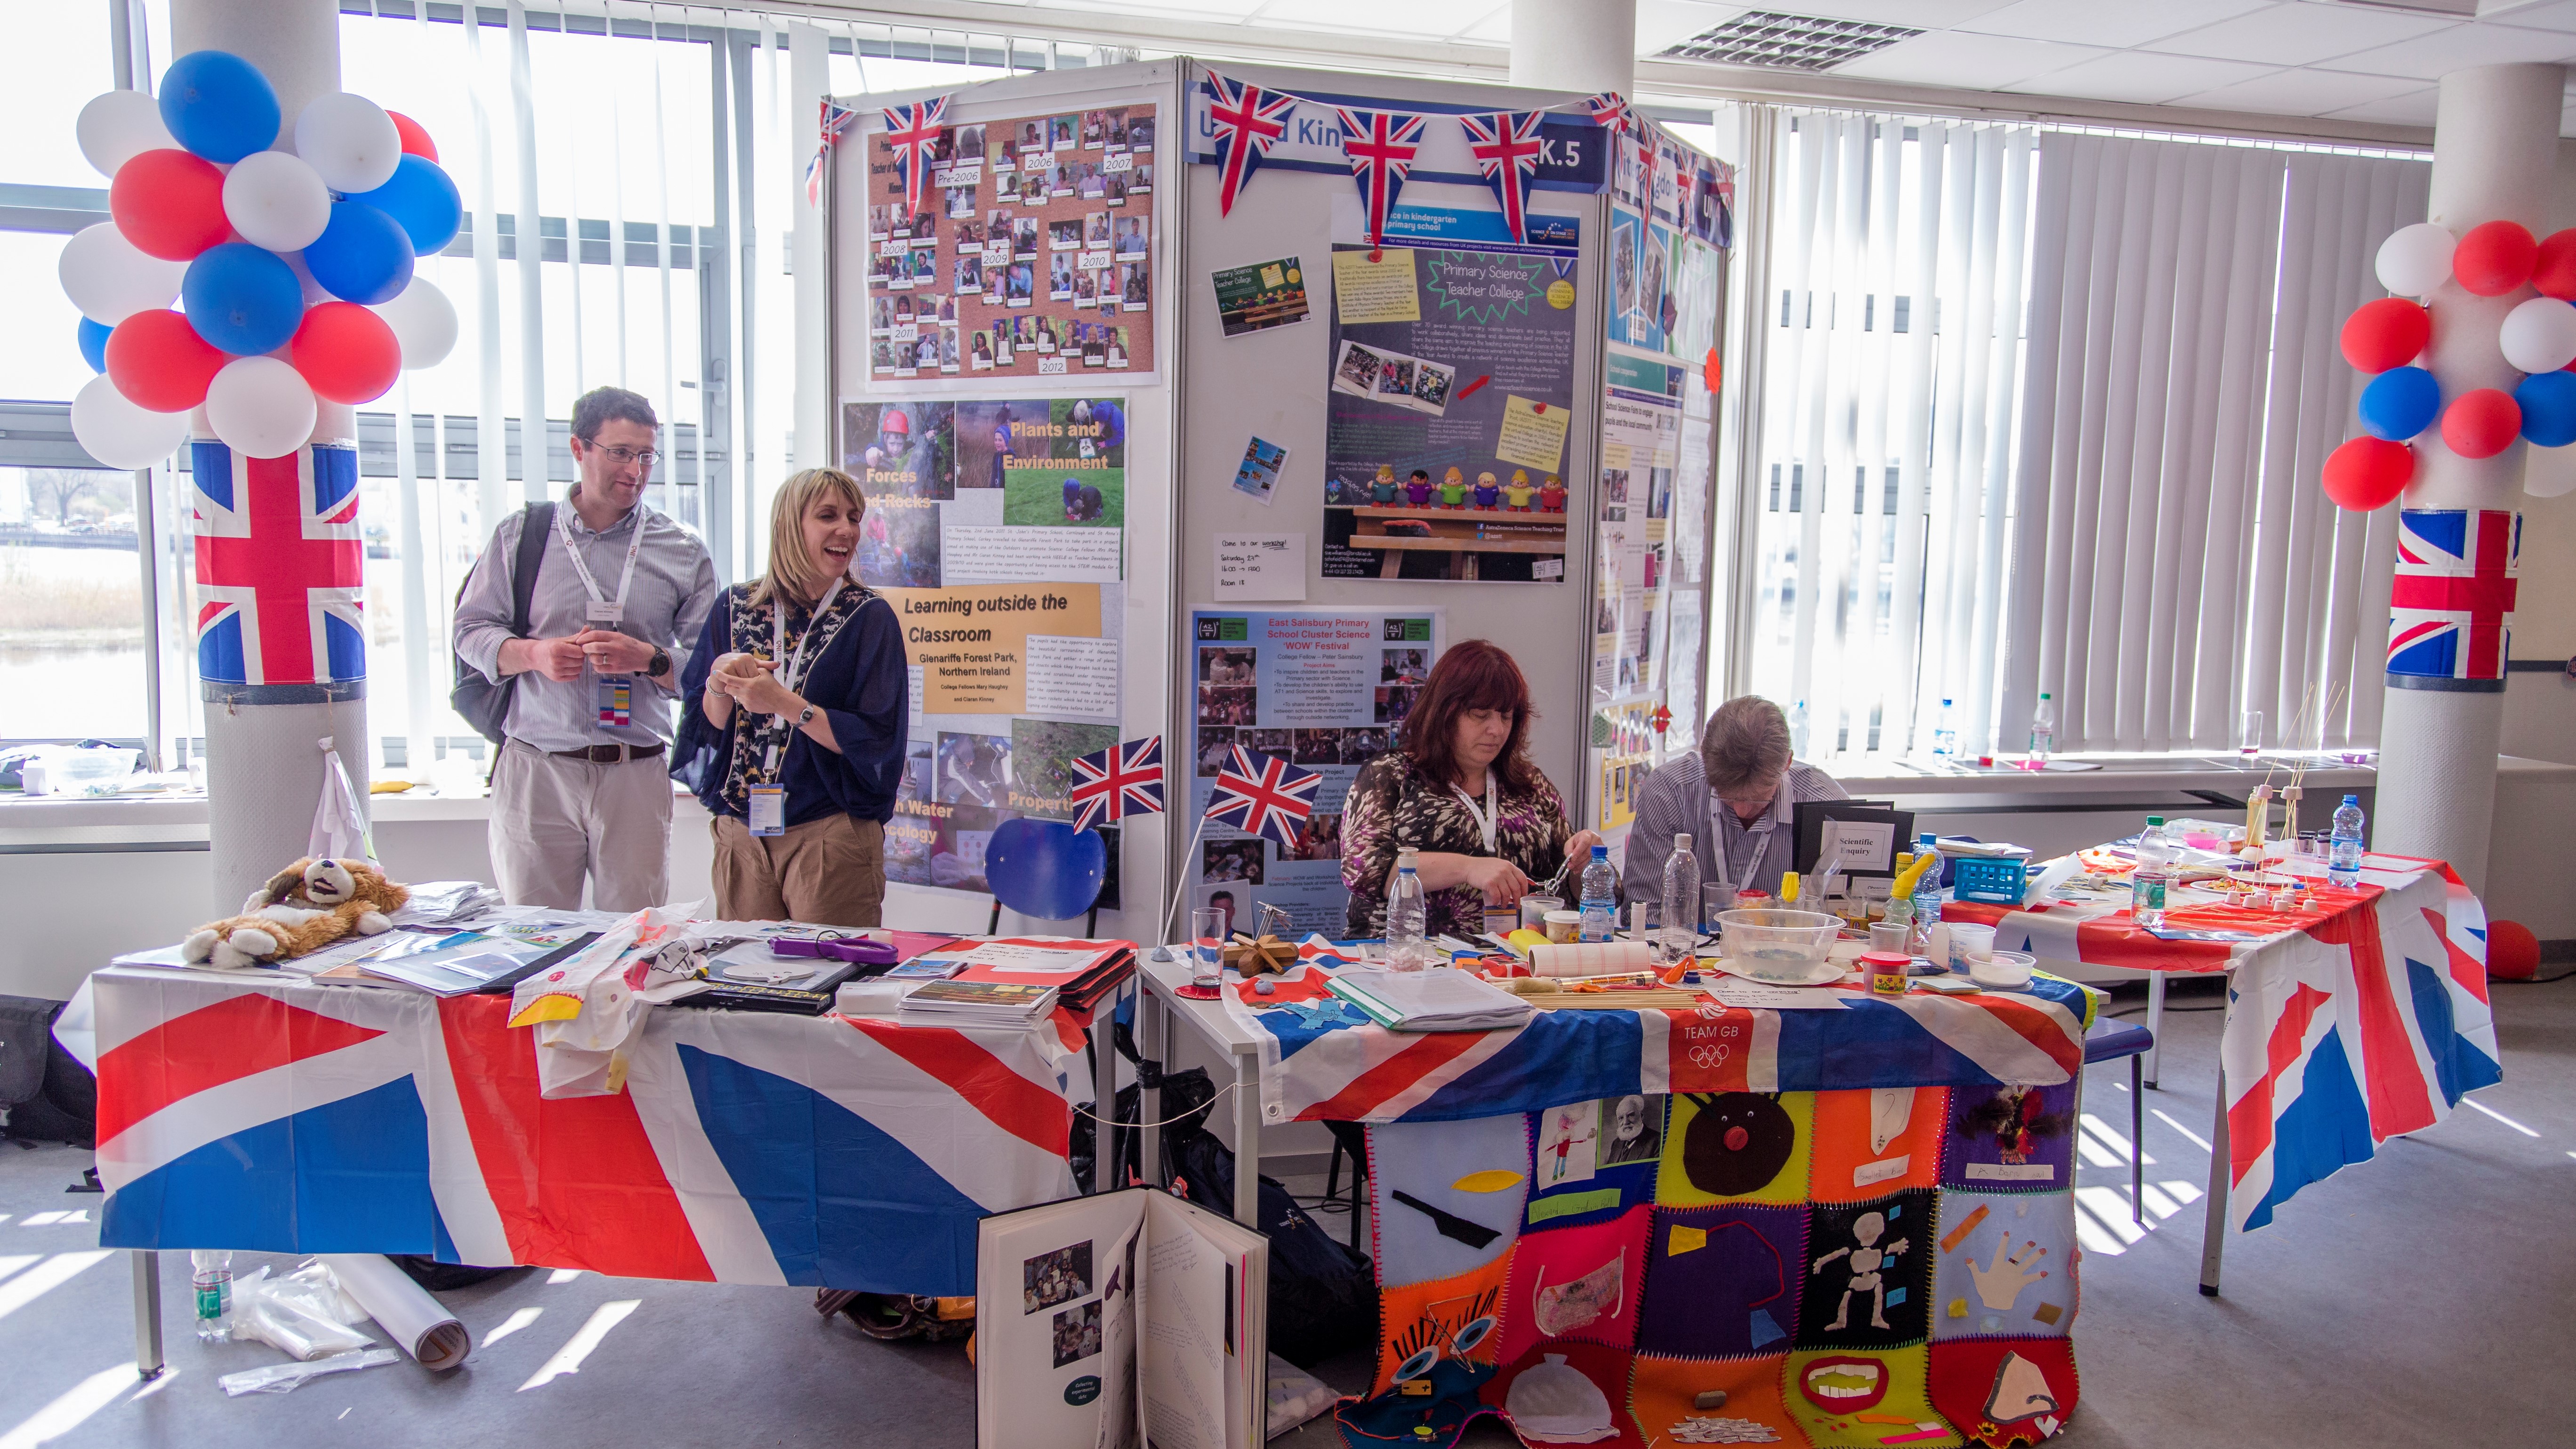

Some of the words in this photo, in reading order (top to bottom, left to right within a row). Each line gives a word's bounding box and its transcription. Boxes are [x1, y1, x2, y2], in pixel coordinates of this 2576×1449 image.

[1028, 158, 1052, 168] 2006
[1106, 159, 1131, 169] 2007
[938, 172, 978, 184] Pre-2006
[1411, 213, 1457, 224] kindergarten
[1388, 221, 1416, 231] primary
[1417, 223, 1441, 231] school
[883, 245, 906, 255] 2008
[983, 254, 1007, 264] 2009
[1083, 257, 1105, 266] 2010
[1213, 271, 1233, 279] Primary
[1234, 267, 1253, 275] Science
[1443, 262, 1486, 280] Primary
[1489, 266, 1528, 281] Science
[1215, 279, 1233, 288] Teacher
[1234, 276, 1251, 284] College
[1446, 282, 1486, 296] Teacher
[1489, 284, 1524, 301] College
[895, 330, 914, 338] 2011
[1042, 363, 1063, 371] 2012
[1606, 401, 1617, 411] School
[1618, 403, 1630, 413] Science
[1605, 417, 1615, 426] pupils
[1011, 422, 1063, 437] Plants
[1068, 421, 1099, 437] and
[1003, 455, 1108, 470] Environment
[866, 468, 916, 483] Forces
[885, 494, 931, 508] Rocks
[1262, 539, 1287, 547] workshop!
[1221, 554, 1244, 564] Saturday
[904, 596, 972, 617] Learning
[977, 594, 1036, 611] outside
[1042, 594, 1067, 610] the
[1291, 619, 1332, 628] Salisbury
[1336, 619, 1369, 628] Primary
[909, 627, 991, 643] Classroom
[1267, 630, 1298, 638] School
[1336, 630, 1369, 638] Science
[919, 653, 961, 663] Glenariffe
[964, 653, 992, 663] Forest
[994, 653, 1017, 663] Park,
[939, 667, 977, 676] Northern
[981, 667, 1010, 676] Ireland
[1008, 791, 1073, 813] Properti
[908, 799, 954, 818] Water
[1840, 848, 1871, 856] Enquiry
[1684, 1027, 1717, 1039] TEAM
[1721, 1026, 1739, 1037] GB
[1977, 1167, 1988, 1176] A
[1998, 1167, 2020, 1177] Barn
[1071, 1386, 1095, 1395] experimental
